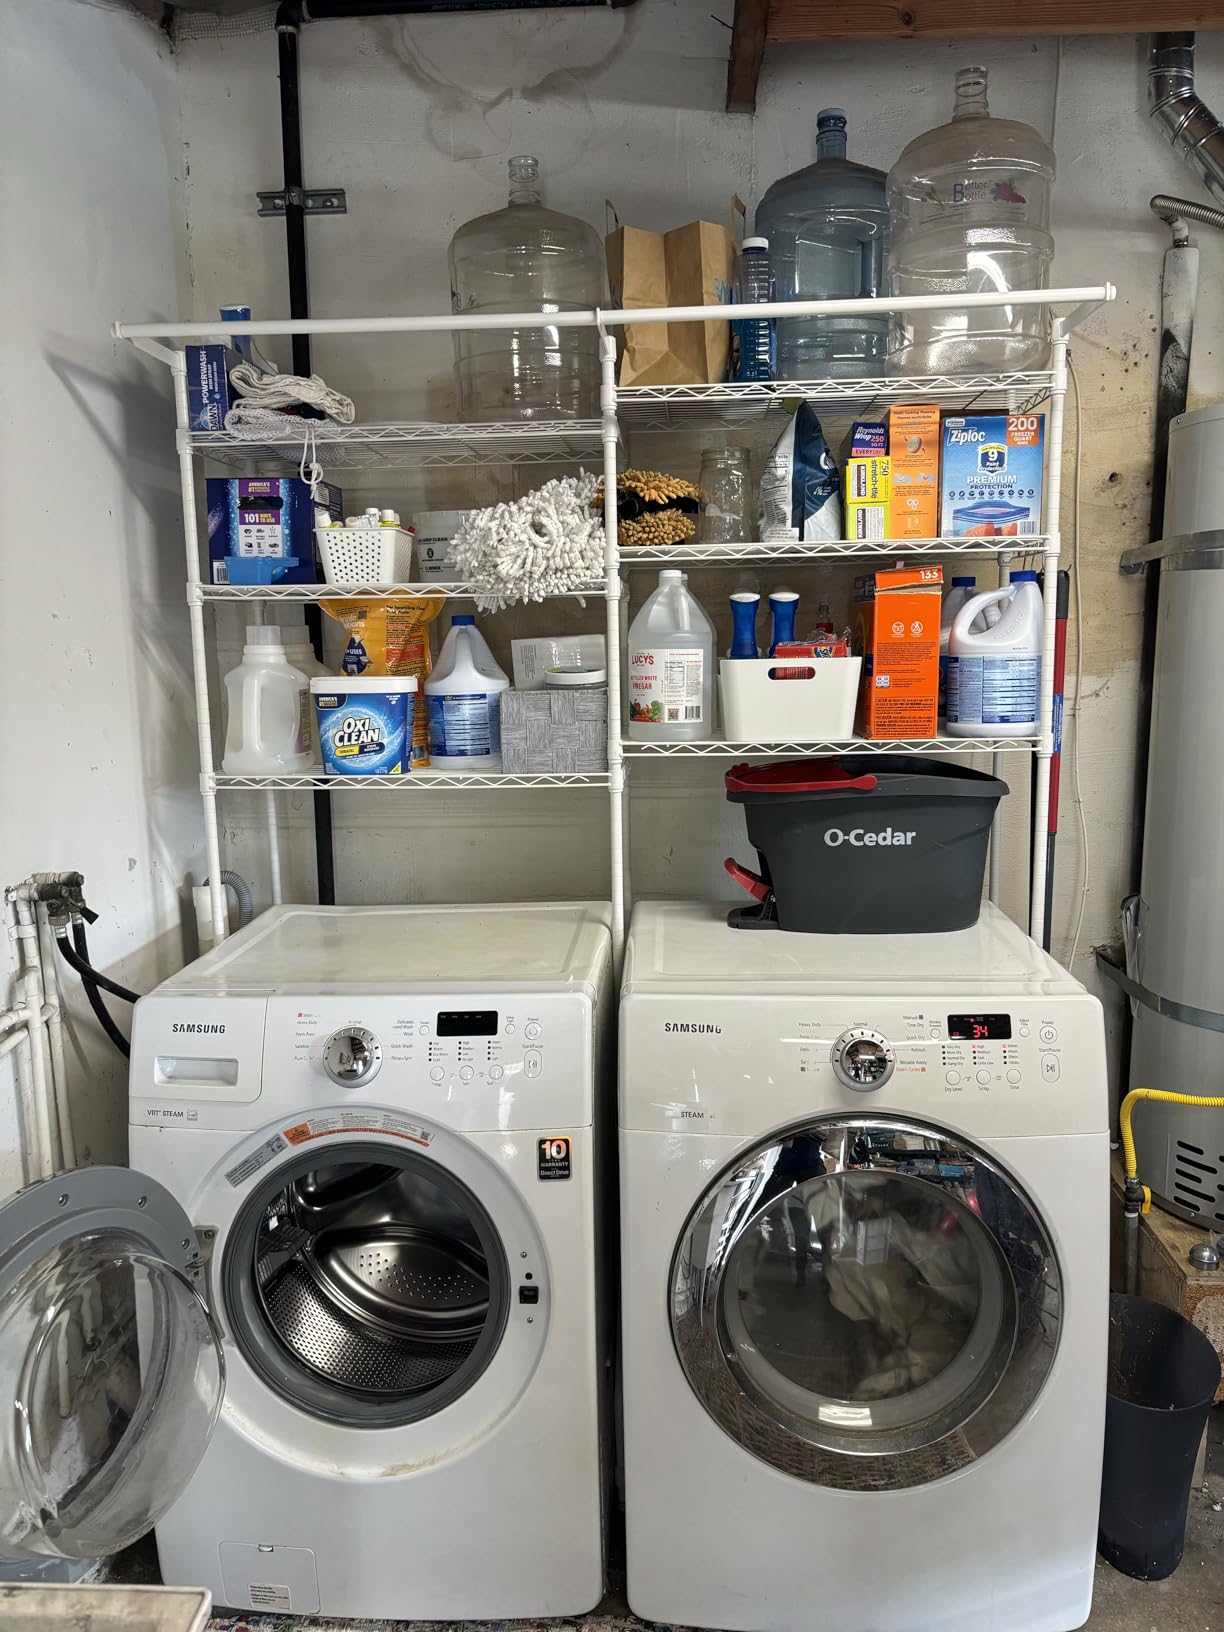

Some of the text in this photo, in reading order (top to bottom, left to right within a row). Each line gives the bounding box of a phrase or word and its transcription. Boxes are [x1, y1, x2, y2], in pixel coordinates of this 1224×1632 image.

[200, 351, 209, 404] POWERWASH
[209, 404, 218, 431] DAWN
[1008, 418, 1037, 430] 200
[854, 433, 871, 441] Wrap
[871, 435, 884, 443] 250
[951, 430, 985, 445] Ziploc
[988, 450, 998, 461] 9
[881, 460, 889, 476] 750
[871, 460, 879, 499] stretch-tite
[967, 475, 1016, 484] PREMIUM
[245, 513, 259, 523] 101
[920, 569, 938, 579] 133
[632, 654, 654, 665] LUCY'S
[343, 717, 370, 733] OXI
[334, 728, 380, 748] CLEAN
[824, 828, 916, 847] O-Cedar
[172, 1023, 226, 1034] SAMSUNG
[665, 1023, 721, 1034] SAMSUNG
[973, 1025, 988, 1038] 34
[162, 1110, 184, 1118] STEAM
[680, 1111, 704, 1119] STEAM
[541, 1140, 567, 1160] 10
